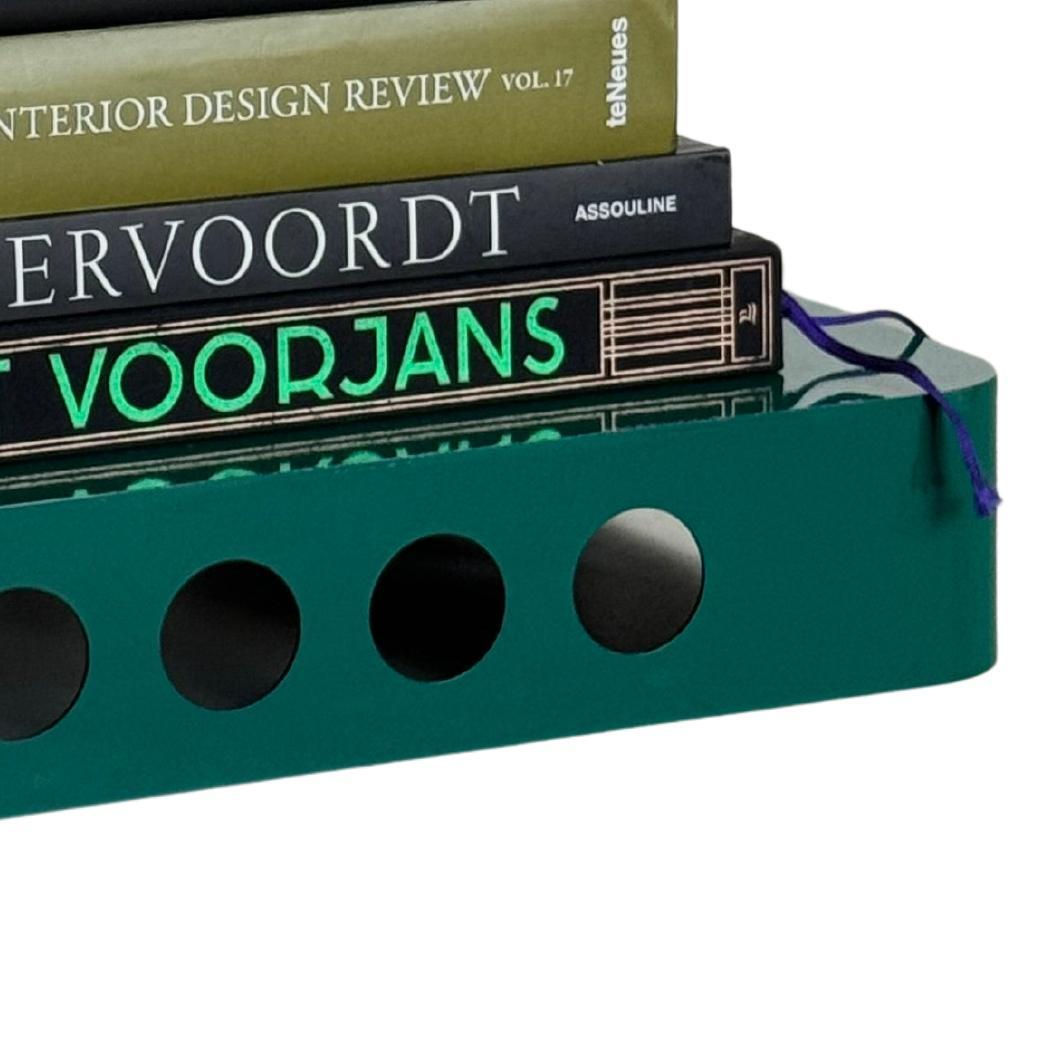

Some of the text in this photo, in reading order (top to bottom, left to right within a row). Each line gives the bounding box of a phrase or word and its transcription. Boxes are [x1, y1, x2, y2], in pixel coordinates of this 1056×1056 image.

[182, 80, 331, 127] DESIGN
[343, 67, 493, 113] REVIEW
[500, 69, 550, 93] VOL.
[552, 67, 575, 89] 17
[604, 15, 630, 130] teNeues
[573, 194, 679, 222] ASSOULINE
[48, 295, 569, 432] VOORJANS
